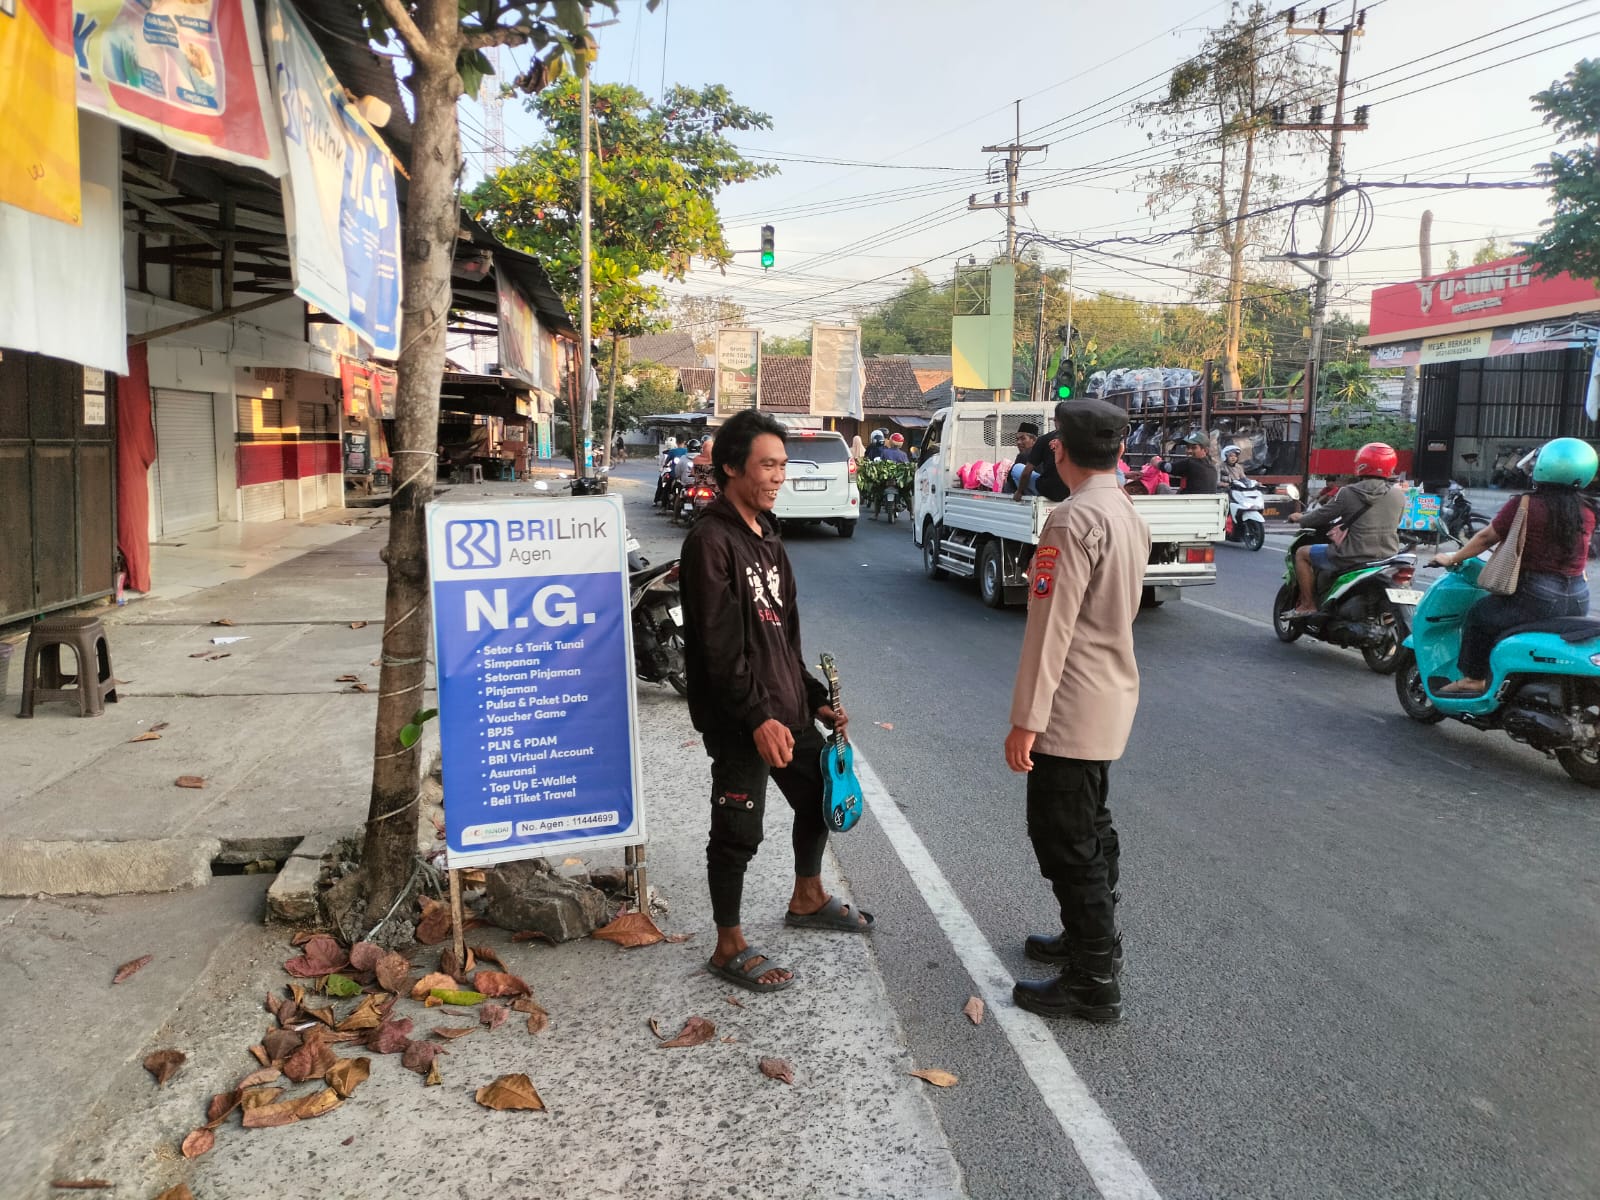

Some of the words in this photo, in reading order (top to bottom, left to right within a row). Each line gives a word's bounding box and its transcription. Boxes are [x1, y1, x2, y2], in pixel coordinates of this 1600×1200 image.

[507, 516, 607, 542] BRILink
[509, 547, 551, 565] Agen
[465, 584, 596, 632] N.G.
[483, 645, 513, 656] Setor
[515, 643, 524, 653] &
[526, 641, 553, 652] Tarik
[554, 639, 585, 651] Tunai
[484, 658, 540, 670] Simpanan
[484, 672, 528, 683] Setoran
[530, 668, 581, 681] Pinjaman
[485, 684, 538, 698] Pinjaman
[486, 700, 516, 710] Pulsa
[518, 698, 527, 708] &
[528, 695, 560, 707] Paket
[563, 693, 589, 703] Data
[486, 712, 533, 724] Voucher
[534, 709, 567, 720] Game
[487, 726, 515, 738] BPJS
[487, 740, 511, 752] PLN
[513, 739, 522, 750] &
[524, 735, 558, 748] PDAM
[488, 754, 508, 766] BRI
[510, 750, 548, 763] Virtual
[550, 746, 594, 759] Account
[489, 765, 536, 779] Asuransi
[489, 782, 511, 794] Top
[512, 780, 529, 792] Up
[531, 775, 577, 788] E-Wallet
[490, 795, 512, 807] Beli
[513, 792, 541, 805] Tiket
[543, 788, 577, 802] Travel
[521, 822, 538, 832] No.
[540, 819, 564, 832] Agen
[572, 813, 614, 825] 11444699
